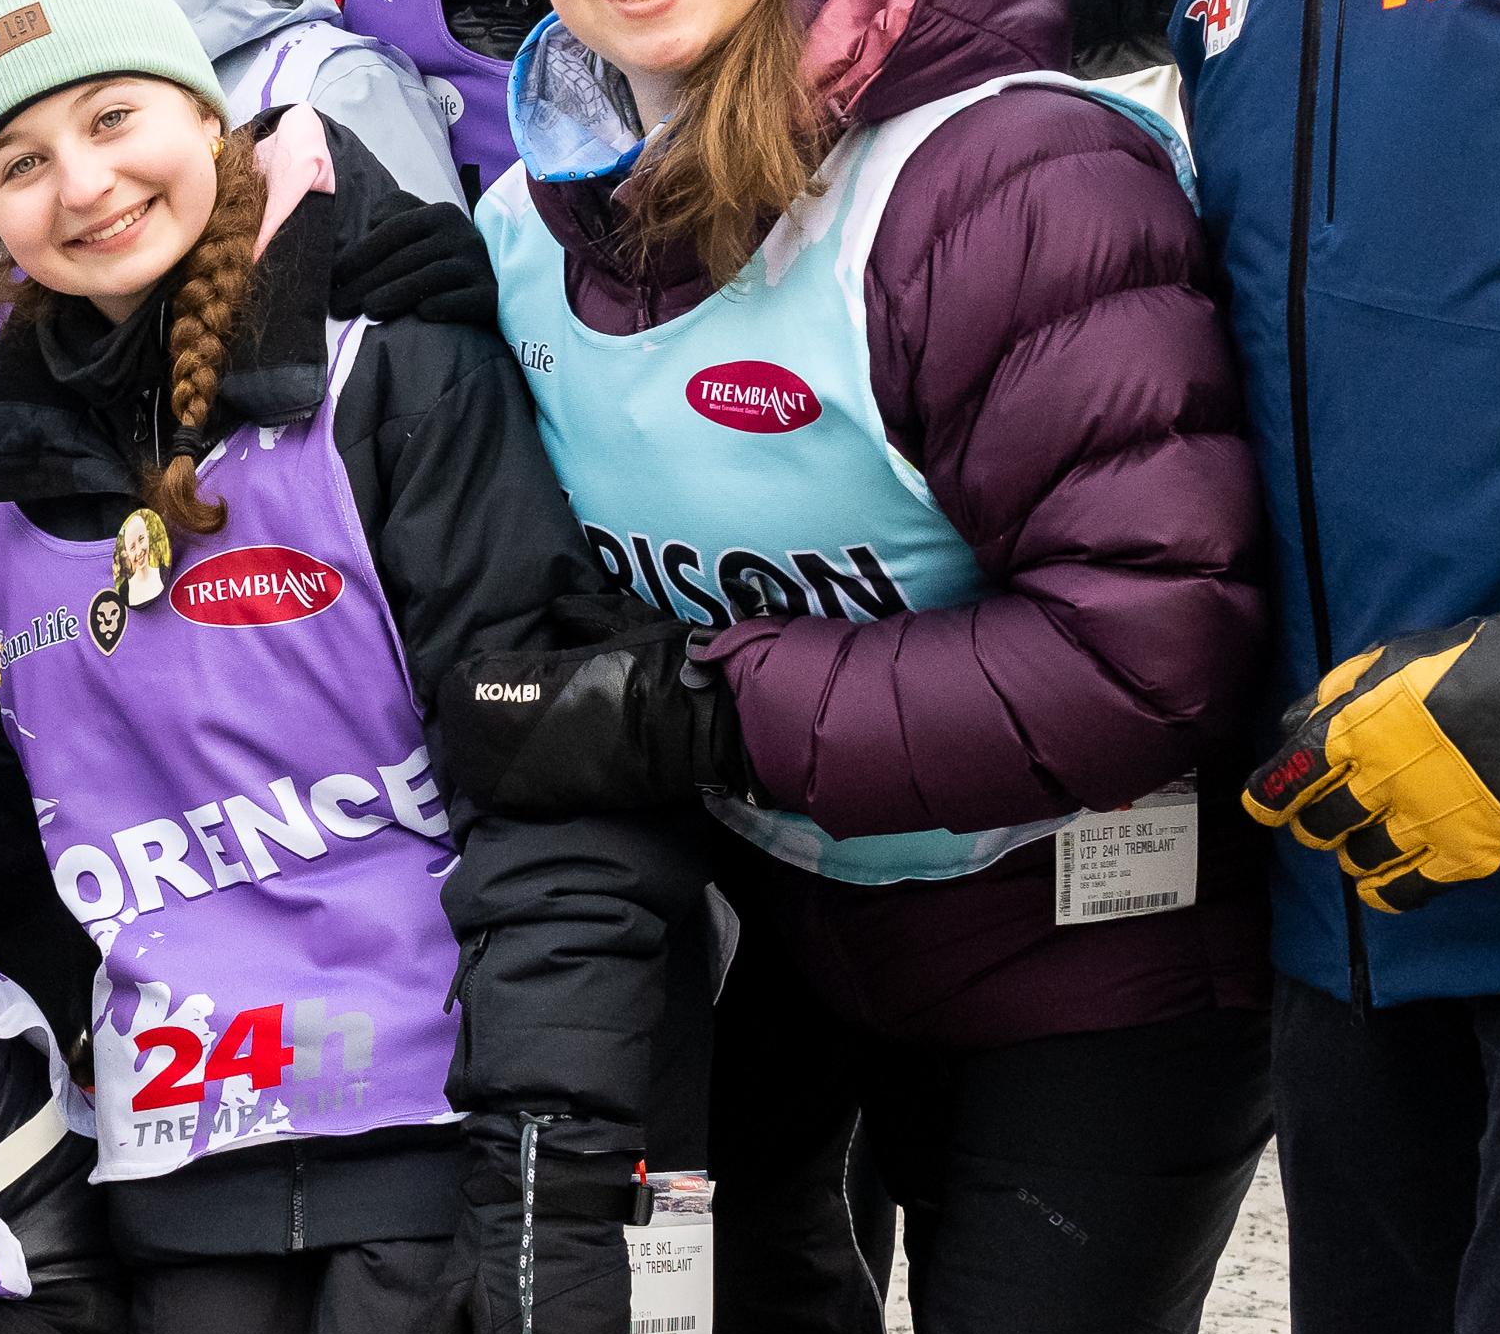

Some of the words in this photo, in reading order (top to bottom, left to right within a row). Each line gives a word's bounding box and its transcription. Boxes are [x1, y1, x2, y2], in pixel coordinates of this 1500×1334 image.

[699, 380, 806, 425] TREMBLANT
[184, 568, 327, 609] TREMBLANT
[32, 607, 80, 651] Life
[475, 683, 541, 702] KOMBI
[1080, 827, 1114, 842] BILLET
[1119, 825, 1131, 838] DE
[1137, 823, 1153, 837] SKI
[1080, 847, 1097, 859] VIP
[1103, 844, 1120, 857] 24H
[1125, 838, 1176, 855] TREMBLANT
[131, 998, 373, 1113] 24h
[134, 1079, 371, 1148] TREMBLANT
[1016, 1188, 1090, 1246] SPYDER
[640, 1243, 651, 1256] DE
[657, 1242, 671, 1255] SKI
[646, 1258, 692, 1274] TREMBLANT
